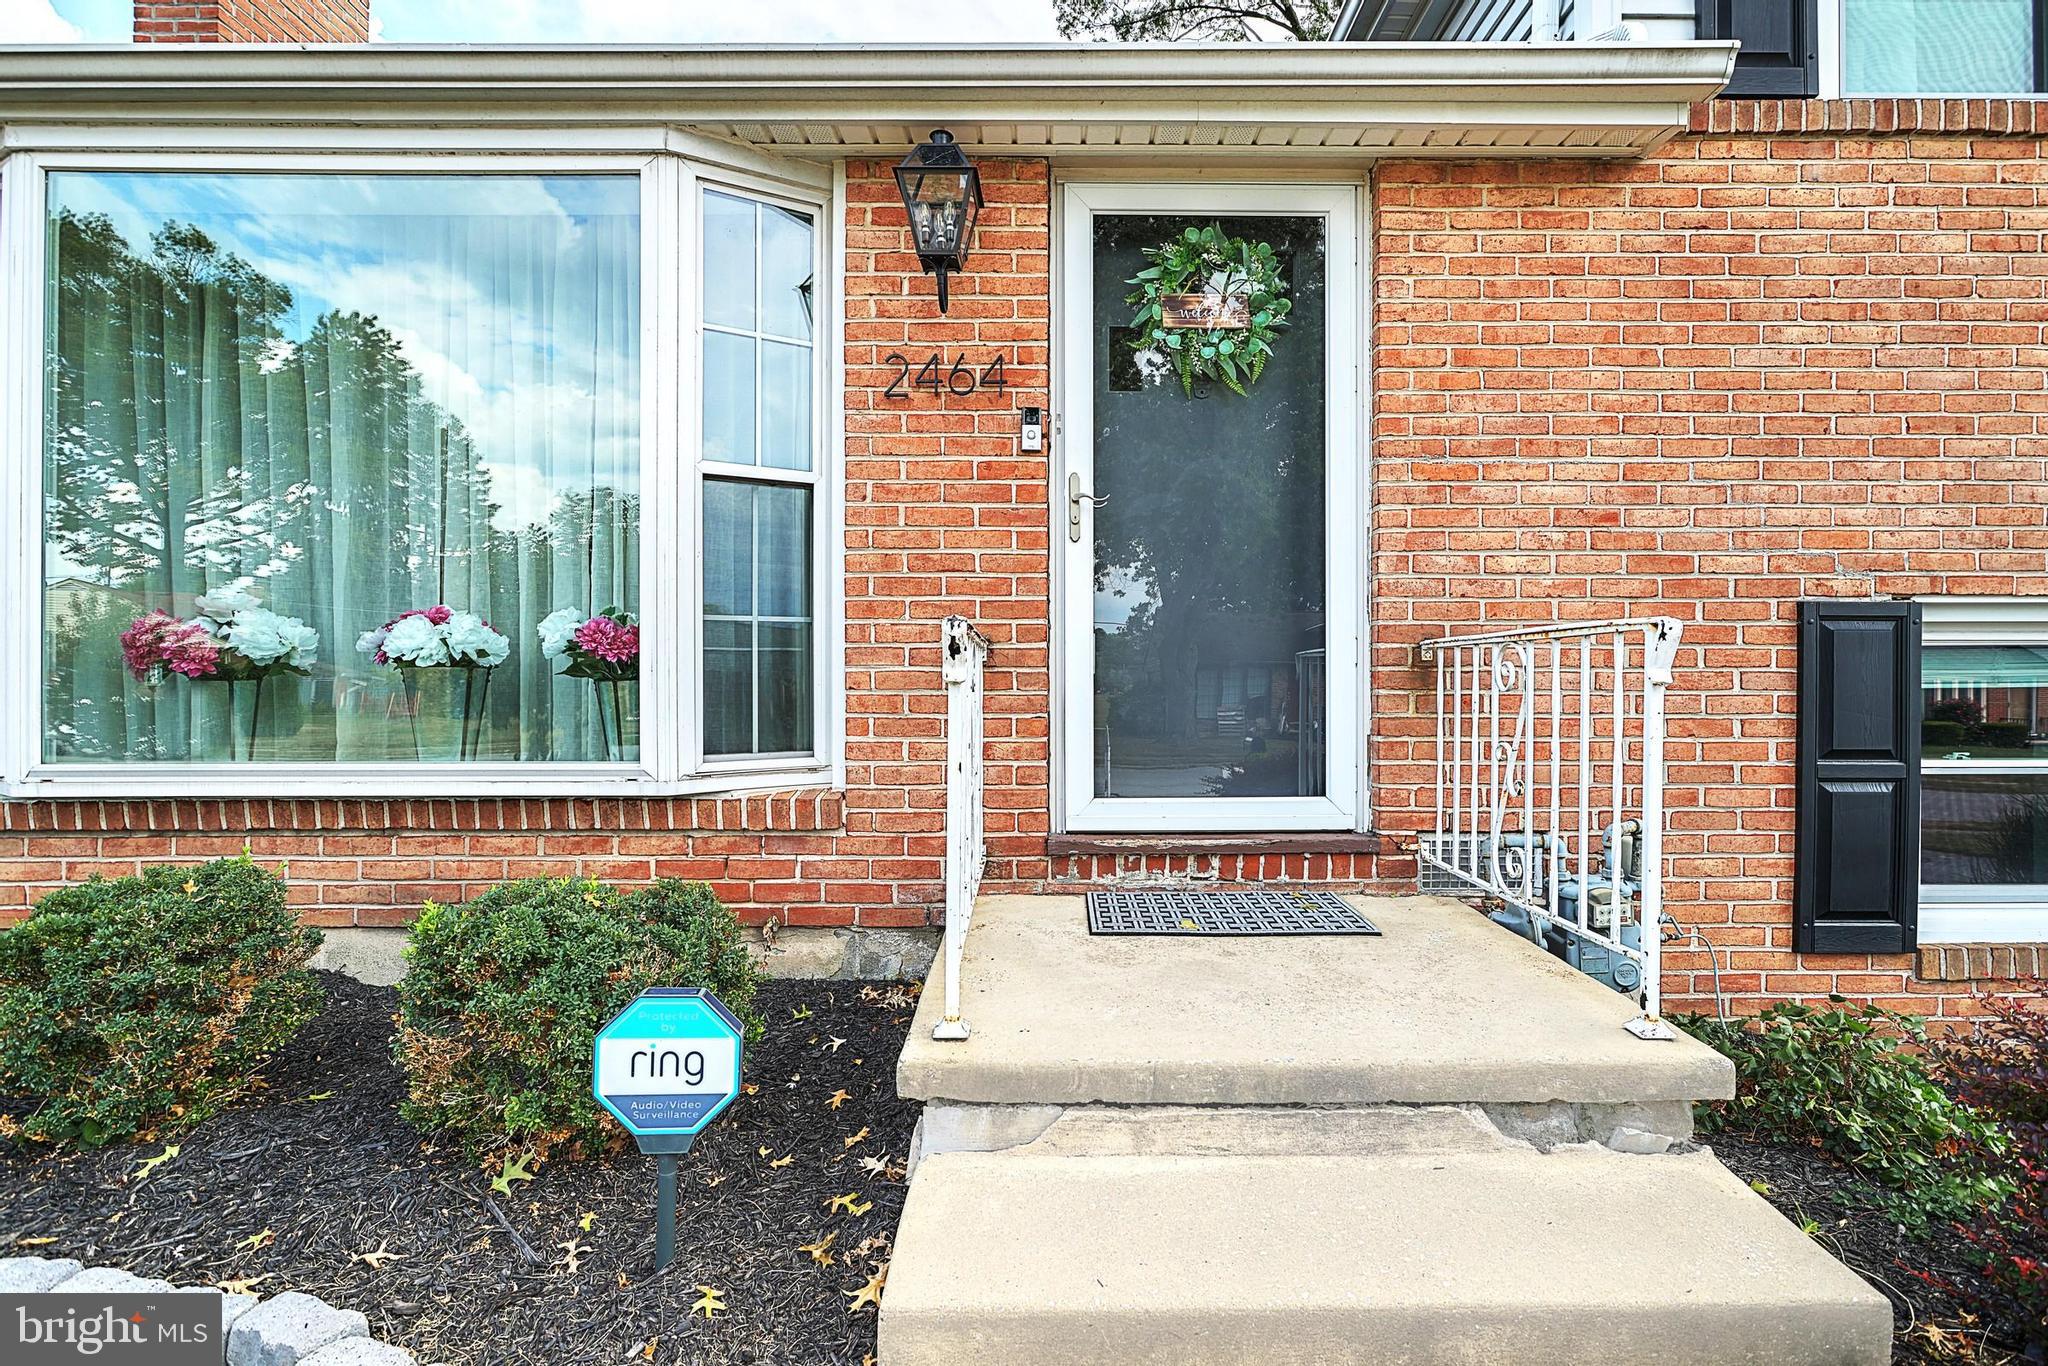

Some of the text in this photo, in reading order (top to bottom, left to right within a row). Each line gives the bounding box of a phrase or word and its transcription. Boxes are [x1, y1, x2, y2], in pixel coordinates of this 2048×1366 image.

[884, 352, 1008, 399] 2464
[638, 1011, 699, 1021] Protected
[661, 1023, 676, 1034] by
[631, 1043, 704, 1086] ring
[631, 1101, 702, 1111] Audio/Video
[633, 1110, 699, 1120] Surveillance
